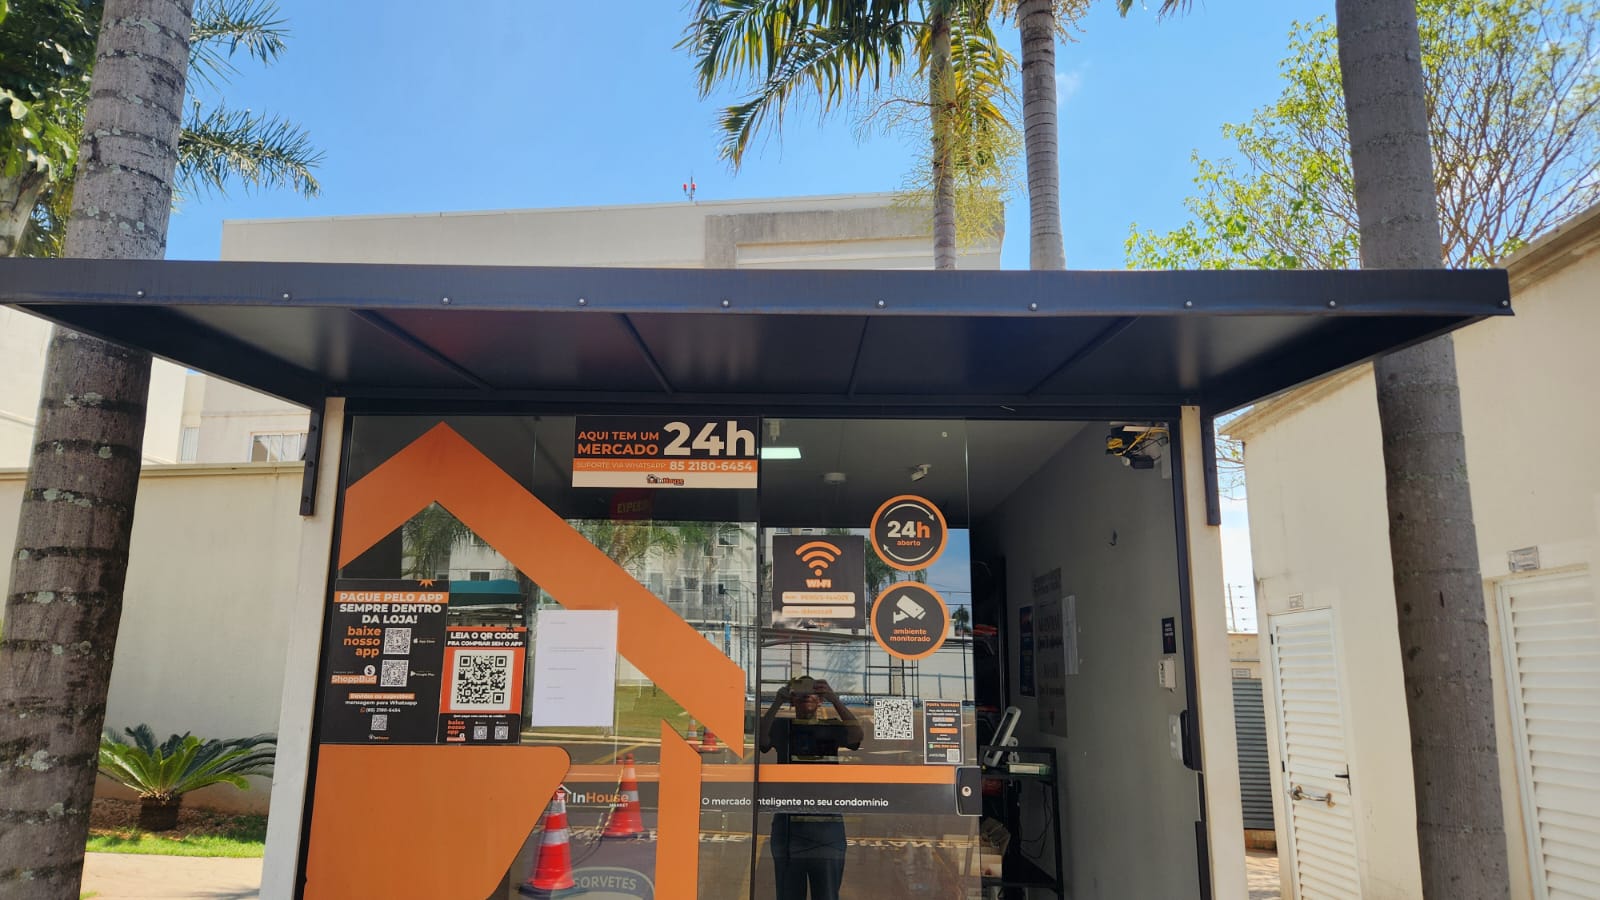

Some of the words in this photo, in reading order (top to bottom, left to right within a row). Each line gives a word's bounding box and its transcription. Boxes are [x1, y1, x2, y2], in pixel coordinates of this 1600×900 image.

[577, 431, 608, 441] AQUI
[611, 431, 637, 441] TEM
[640, 431, 659, 441] UM
[663, 421, 755, 456] 24h
[577, 443, 659, 456] MERCADO
[669, 461, 684, 471] 85
[688, 461, 752, 471] 2180-6454
[887, 520, 931, 538] 24h
[340, 593, 381, 602] PAGUE
[384, 593, 416, 603] PELO
[418, 593, 443, 603] APP
[339, 603, 389, 613] SEMPRE
[391, 604, 442, 613] DENTRO
[361, 614, 380, 624] DA
[382, 615, 418, 624] LOJA!
[347, 625, 382, 636] baixe
[480, 632, 493, 640] QR
[494, 632, 519, 640] CODE
[890, 634, 931, 642] monitorado
[343, 638, 381, 646] nosso
[355, 648, 380, 658] app
[572, 792, 629, 803] InHouse
[702, 797, 710, 806] O
[711, 797, 752, 806] mercado
[757, 797, 801, 807] nteligente
[834, 797, 889, 807] condomínio
[573, 876, 637, 890] SORVETES
